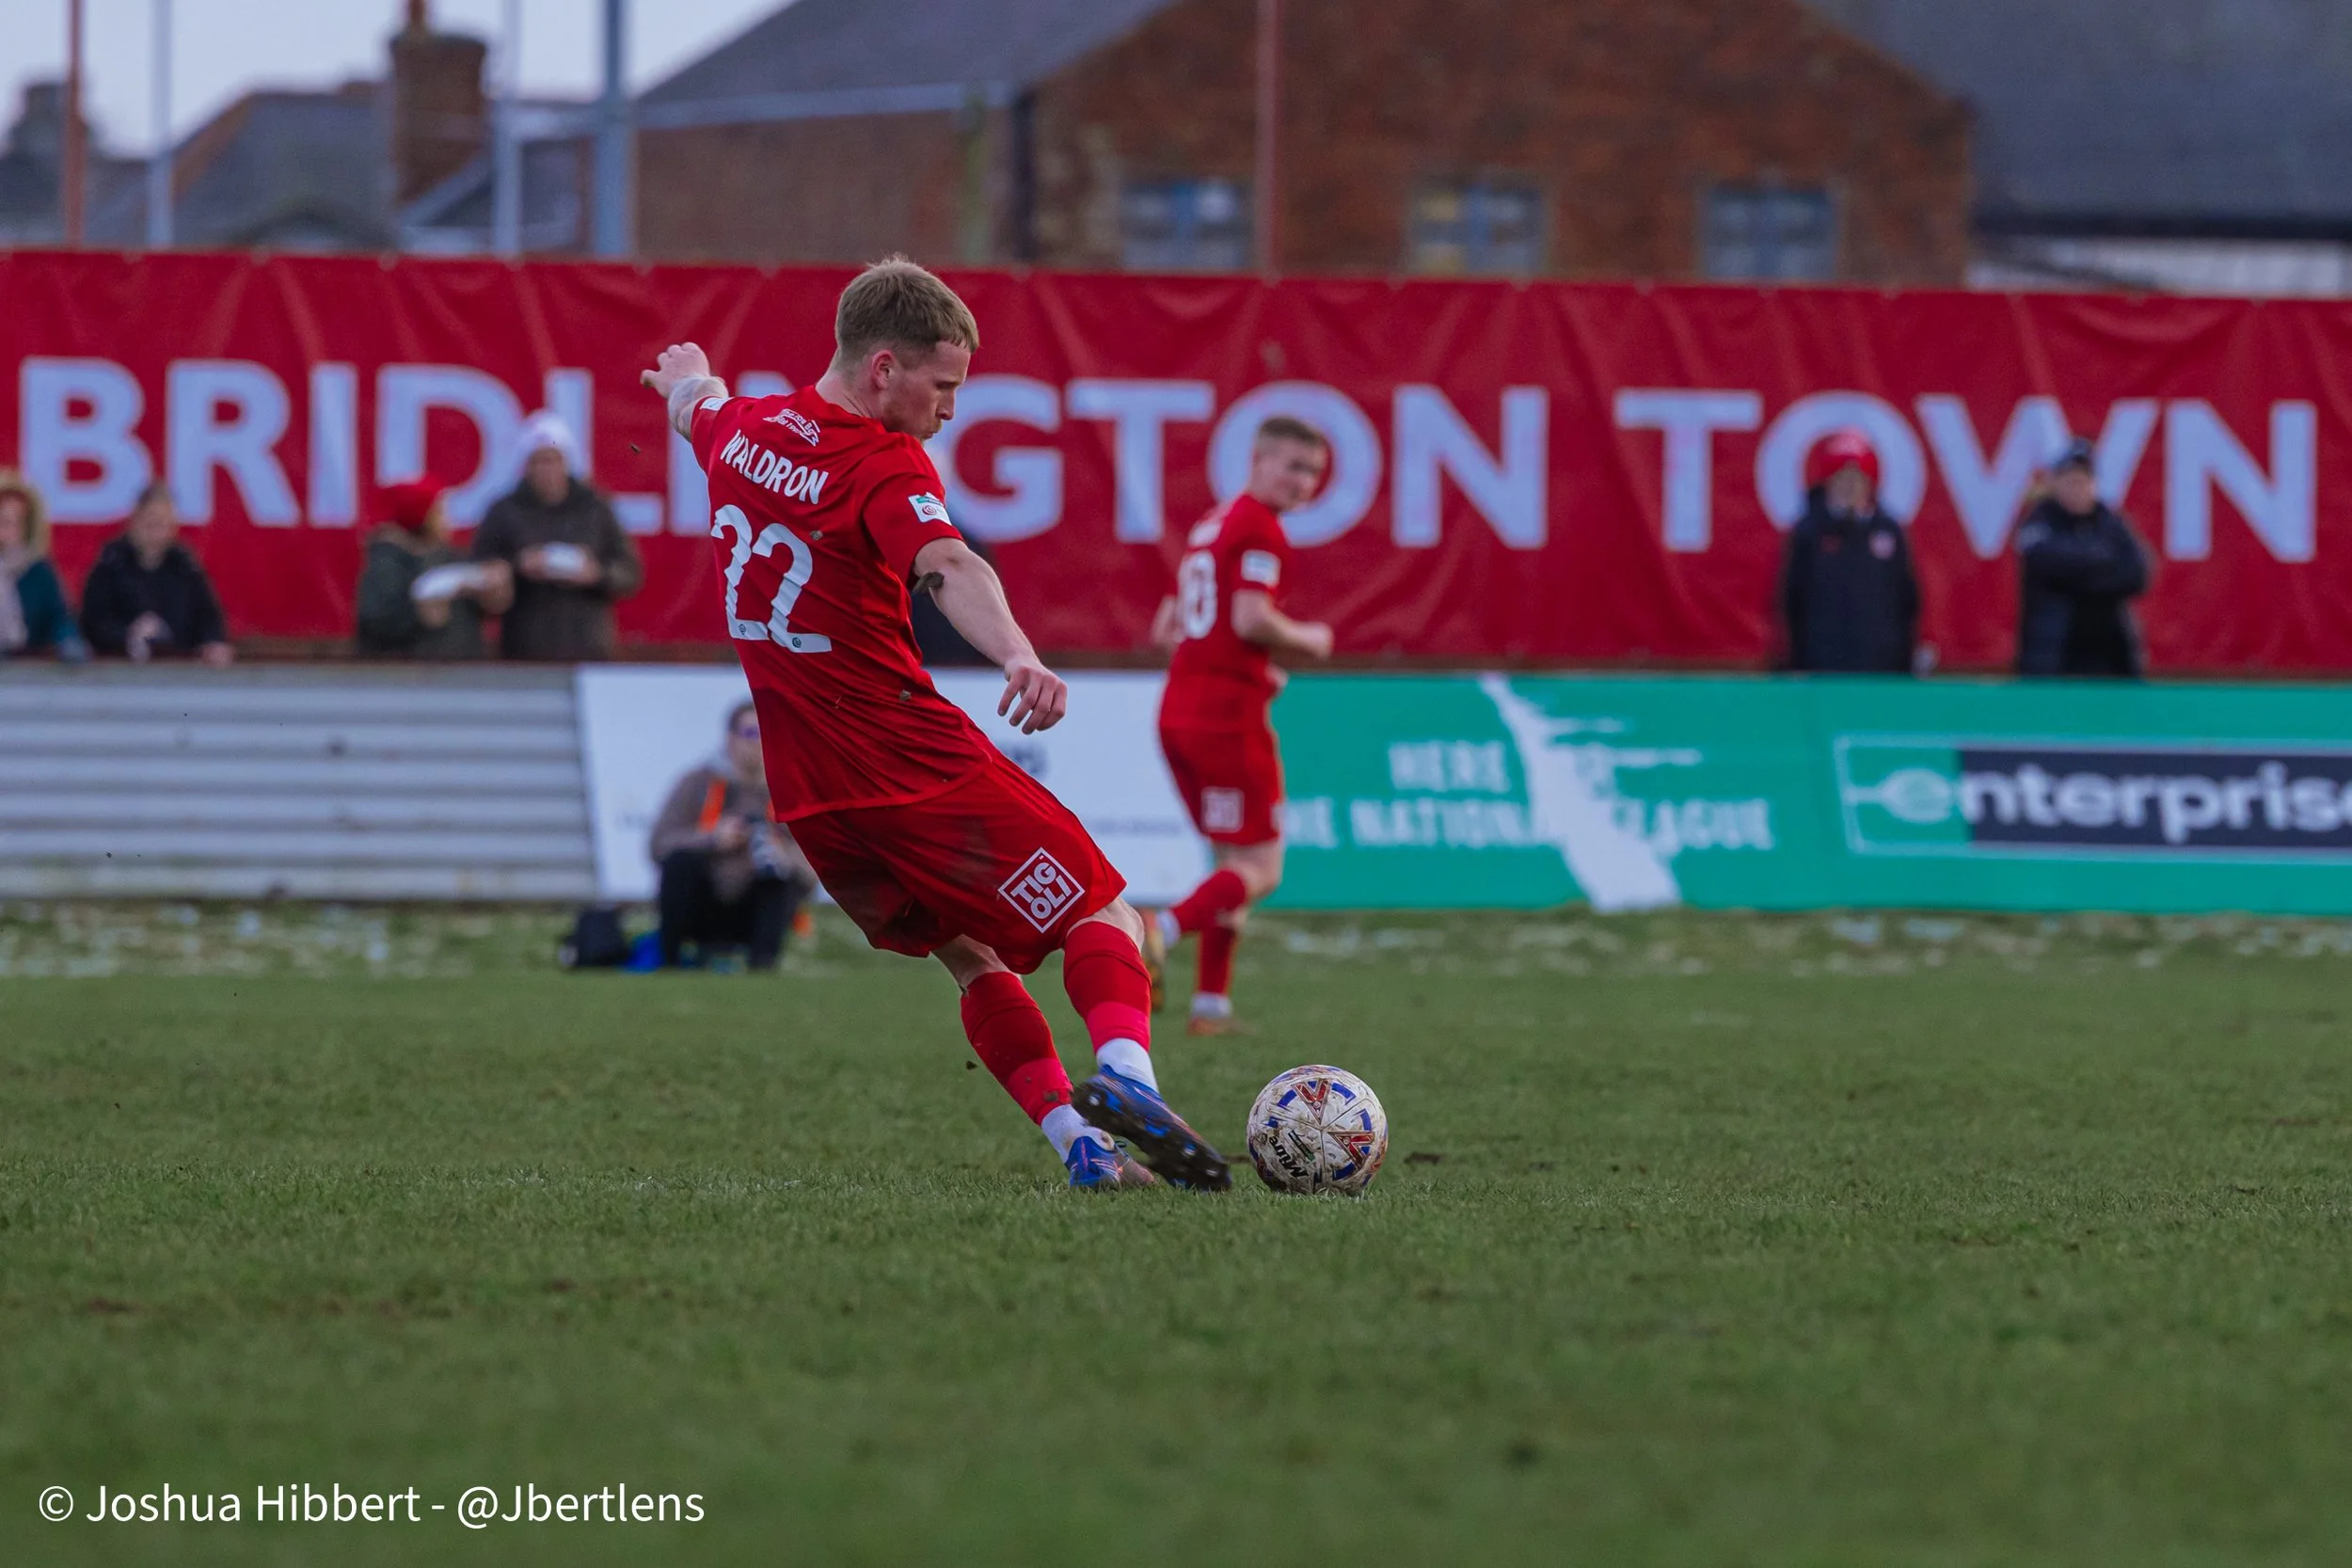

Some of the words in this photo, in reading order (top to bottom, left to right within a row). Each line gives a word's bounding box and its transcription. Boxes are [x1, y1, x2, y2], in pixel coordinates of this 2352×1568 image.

[19, 356, 1549, 549] BRIDLIGTON
[1613, 387, 2318, 562] TOWN
[720, 428, 829, 505] WALDRON
[710, 504, 833, 654] 22
[1010, 862, 1057, 904] TIG
[1030, 875, 1073, 920] OLI
